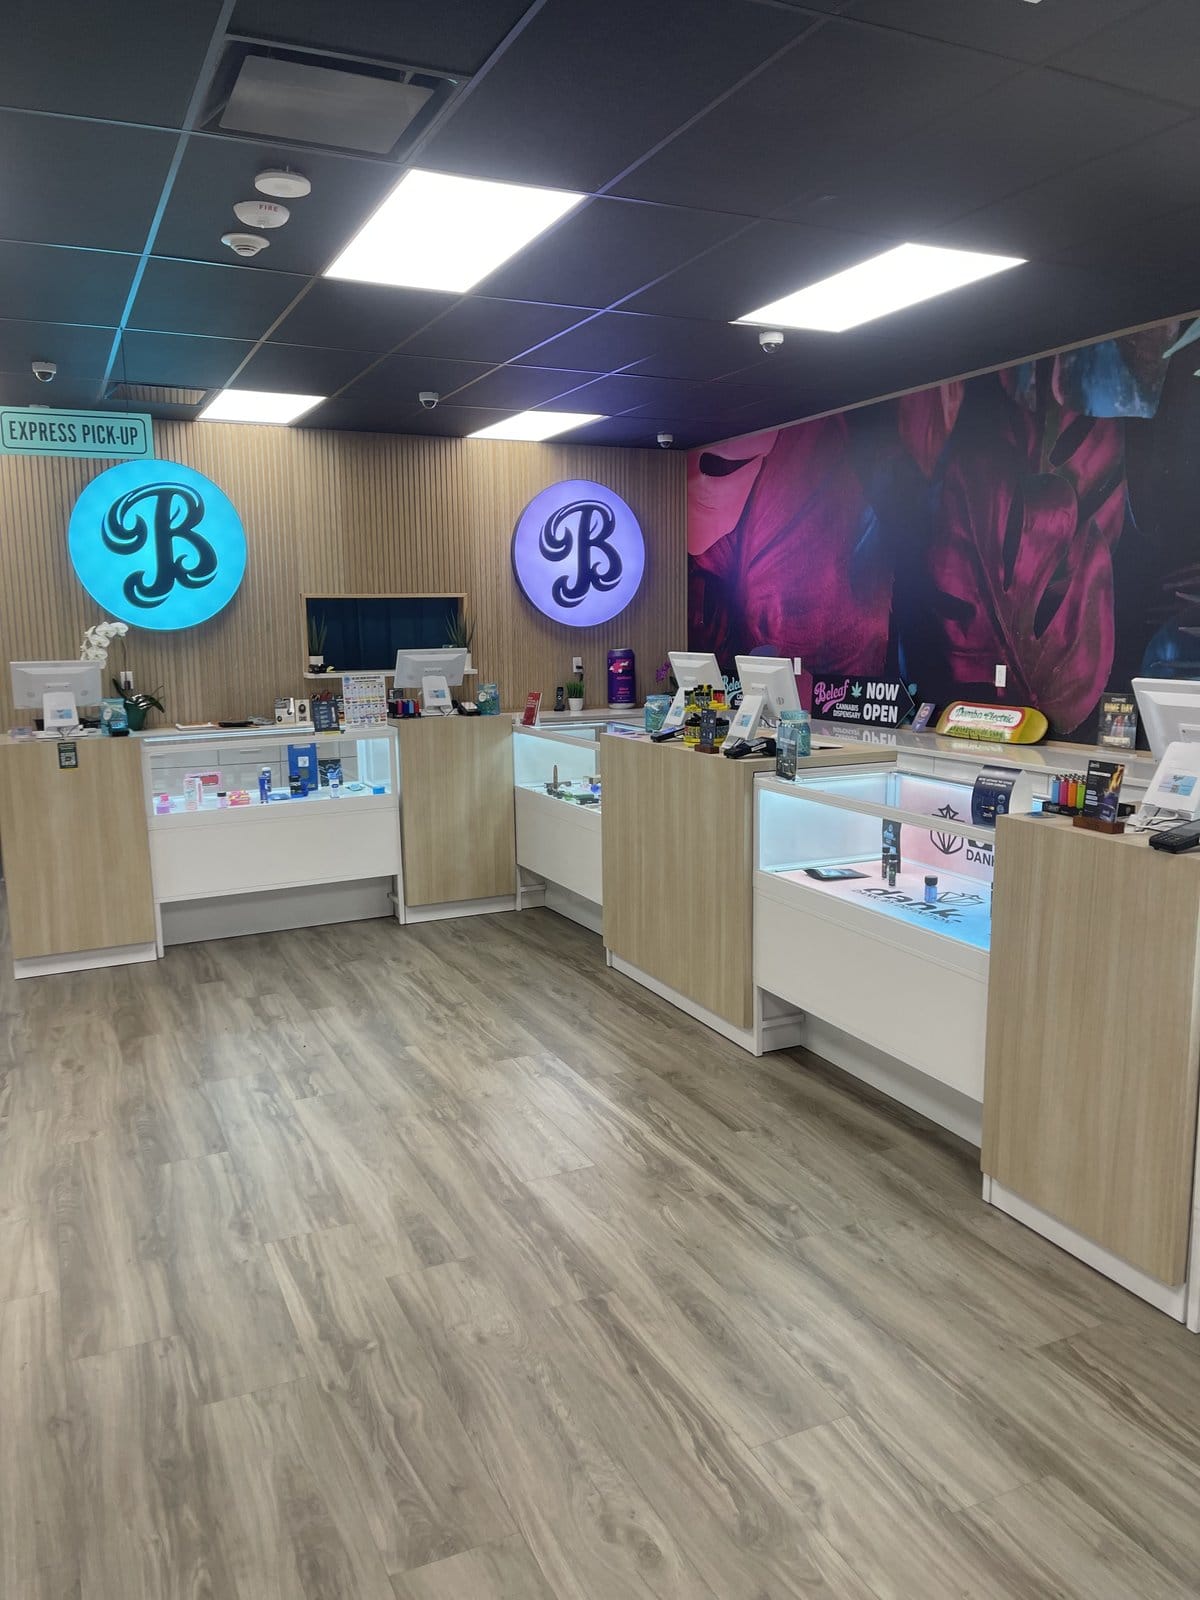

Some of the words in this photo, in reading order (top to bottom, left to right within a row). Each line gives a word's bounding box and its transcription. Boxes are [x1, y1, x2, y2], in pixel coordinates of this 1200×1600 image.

[259, 204, 279, 212] FIRE
[9, 421, 77, 443] EXPRESS
[82, 424, 138, 446] PICK-UP
[814, 679, 850, 713] Beleaf
[866, 682, 899, 701] NOW
[833, 709, 861, 719] DISPENSARY
[835, 703, 859, 711] CANNABIS
[863, 703, 898, 723] OPEN
[967, 849, 994, 867] DAN
